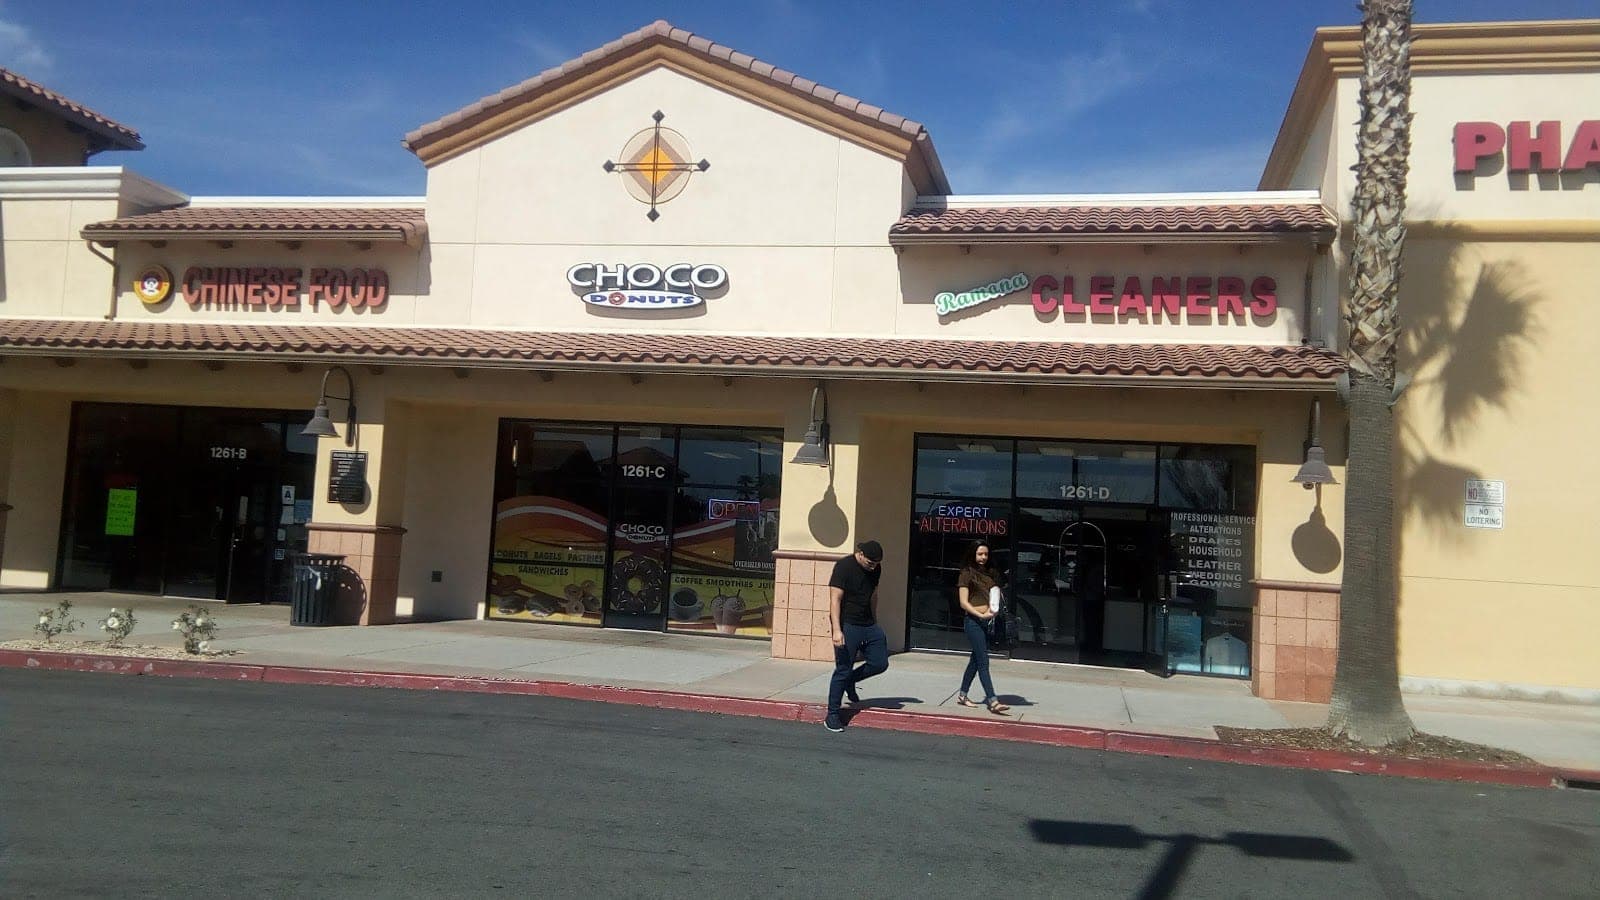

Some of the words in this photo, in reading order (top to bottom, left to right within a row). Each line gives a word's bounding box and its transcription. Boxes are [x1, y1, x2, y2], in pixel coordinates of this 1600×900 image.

[1453, 120, 1600, 173] PHA
[566, 262, 728, 289] CHOCO
[182, 266, 303, 306] CHINESE
[308, 267, 390, 308] FOOD
[934, 272, 1030, 316] Ramona
[589, 291, 695, 306] DONUTS
[1030, 274, 1278, 317] CLEANERS
[210, 446, 248, 460] 1261-B
[621, 464, 667, 479] 1261-C
[1059, 484, 1110, 501] 1261-D
[710, 501, 760, 518] OPEN
[938, 505, 990, 519] EXPERT
[919, 517, 1008, 536] ALTERATIONS
[1466, 517, 1500, 525] LOITERING
[619, 523, 665, 536] CHOCO
[1189, 525, 1242, 536] ALTERATIONS
[1189, 536, 1242, 546] DRAPES
[495, 550, 528, 558] DONUTS
[534, 551, 562, 560] BAGELS
[567, 553, 604, 562] PASTRIES
[1189, 545, 1242, 557] HOUSEHOLD
[518, 565, 569, 576] SANDWICHES
[1188, 559, 1241, 571] LEATHER
[674, 576, 703, 585] COFFEE
[706, 577, 754, 588] SMOOTHIES
[1189, 571, 1242, 582] WEDDING
[1189, 579, 1242, 589] GOWNS
